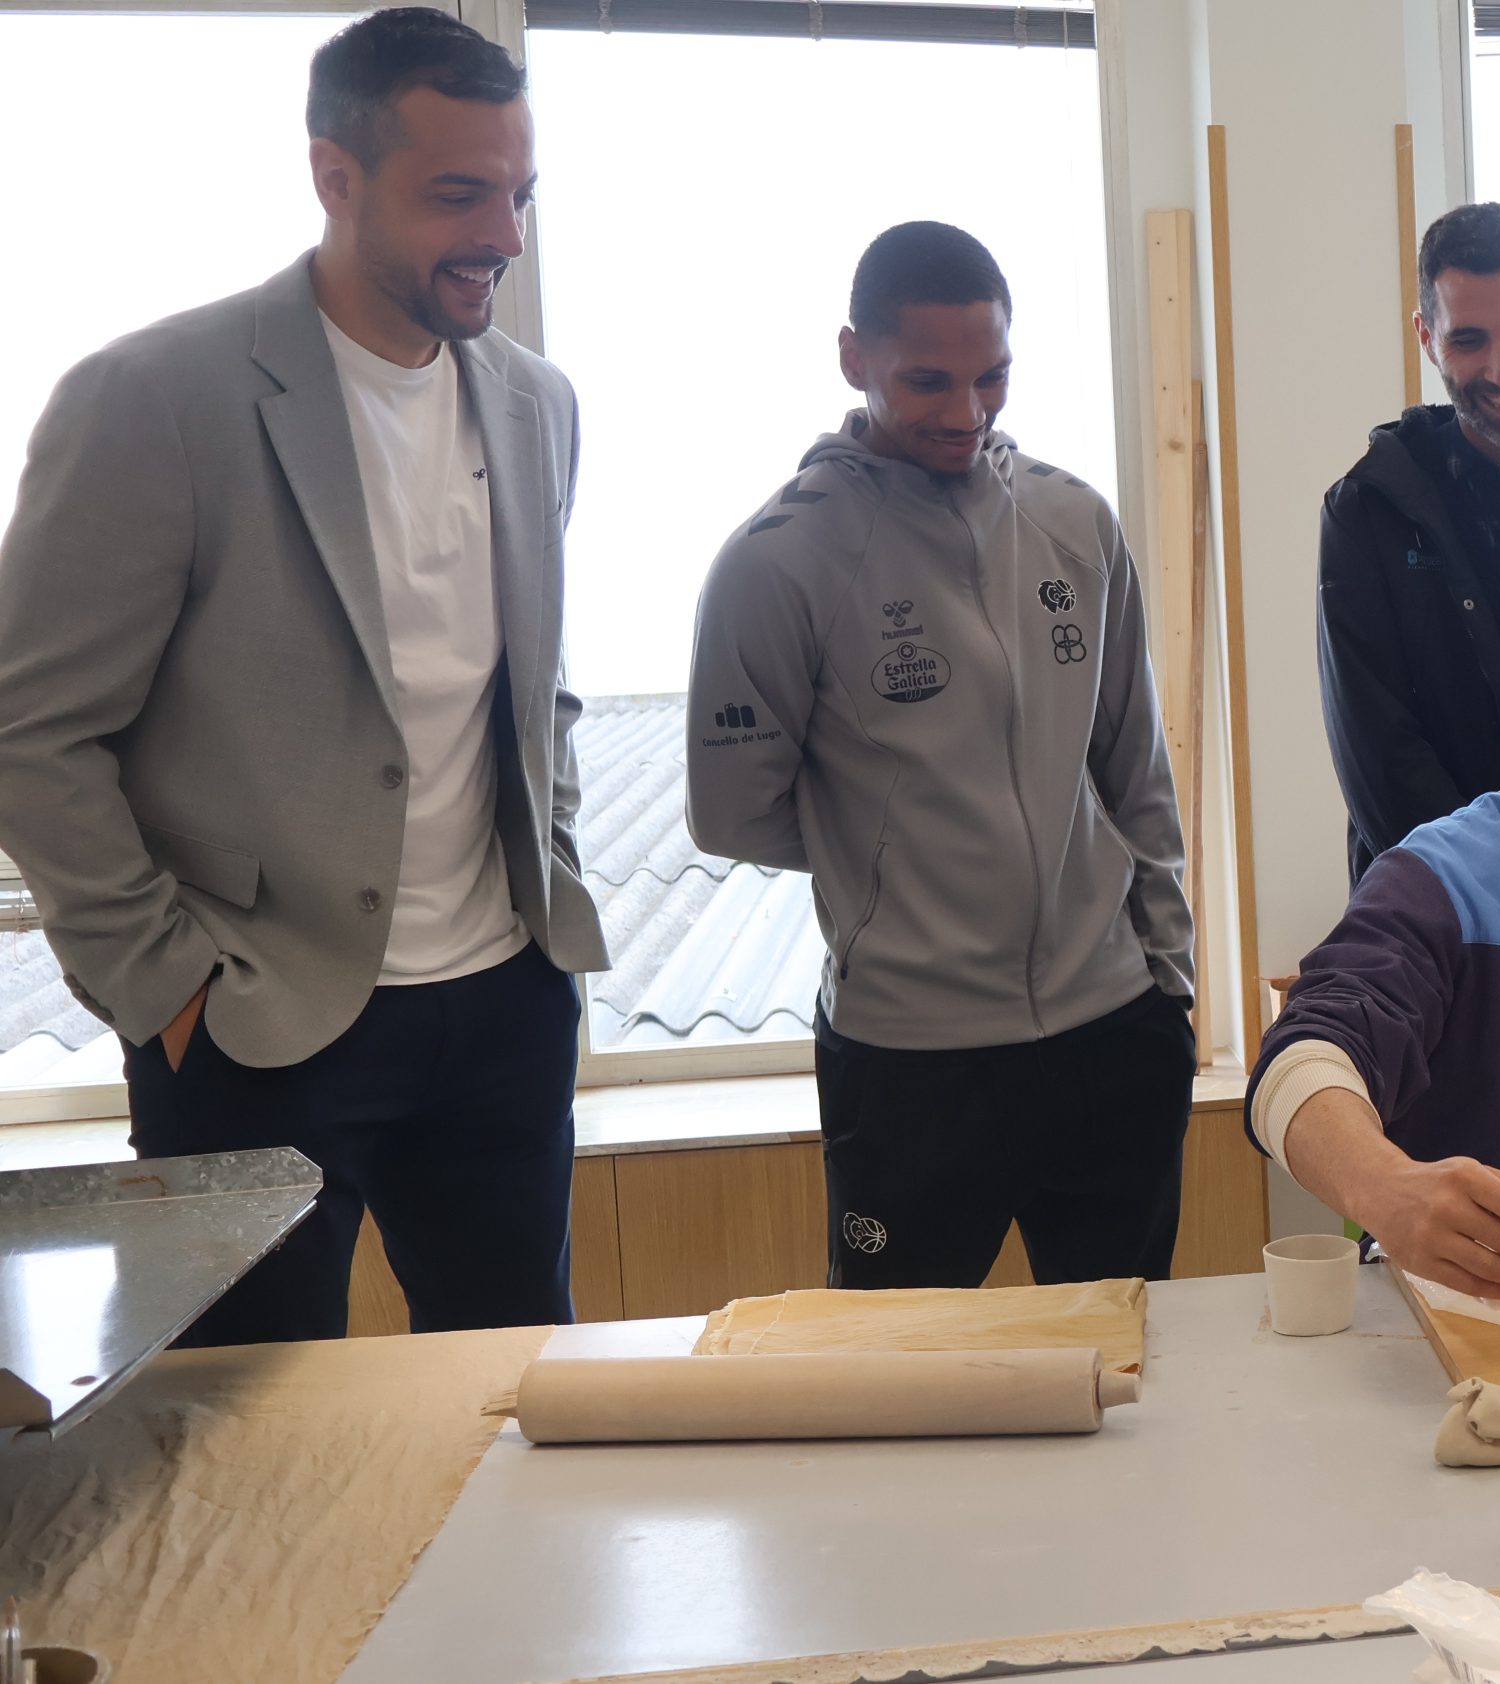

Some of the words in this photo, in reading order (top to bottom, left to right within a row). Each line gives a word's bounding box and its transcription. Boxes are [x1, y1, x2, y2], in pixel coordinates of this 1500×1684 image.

[882, 624, 924, 641] hummel
[884, 658, 937, 677] Estrella
[887, 672, 937, 690] Galicia
[702, 736, 739, 748] Concello
[741, 733, 754, 743] de
[757, 730, 782, 741] Lugo
